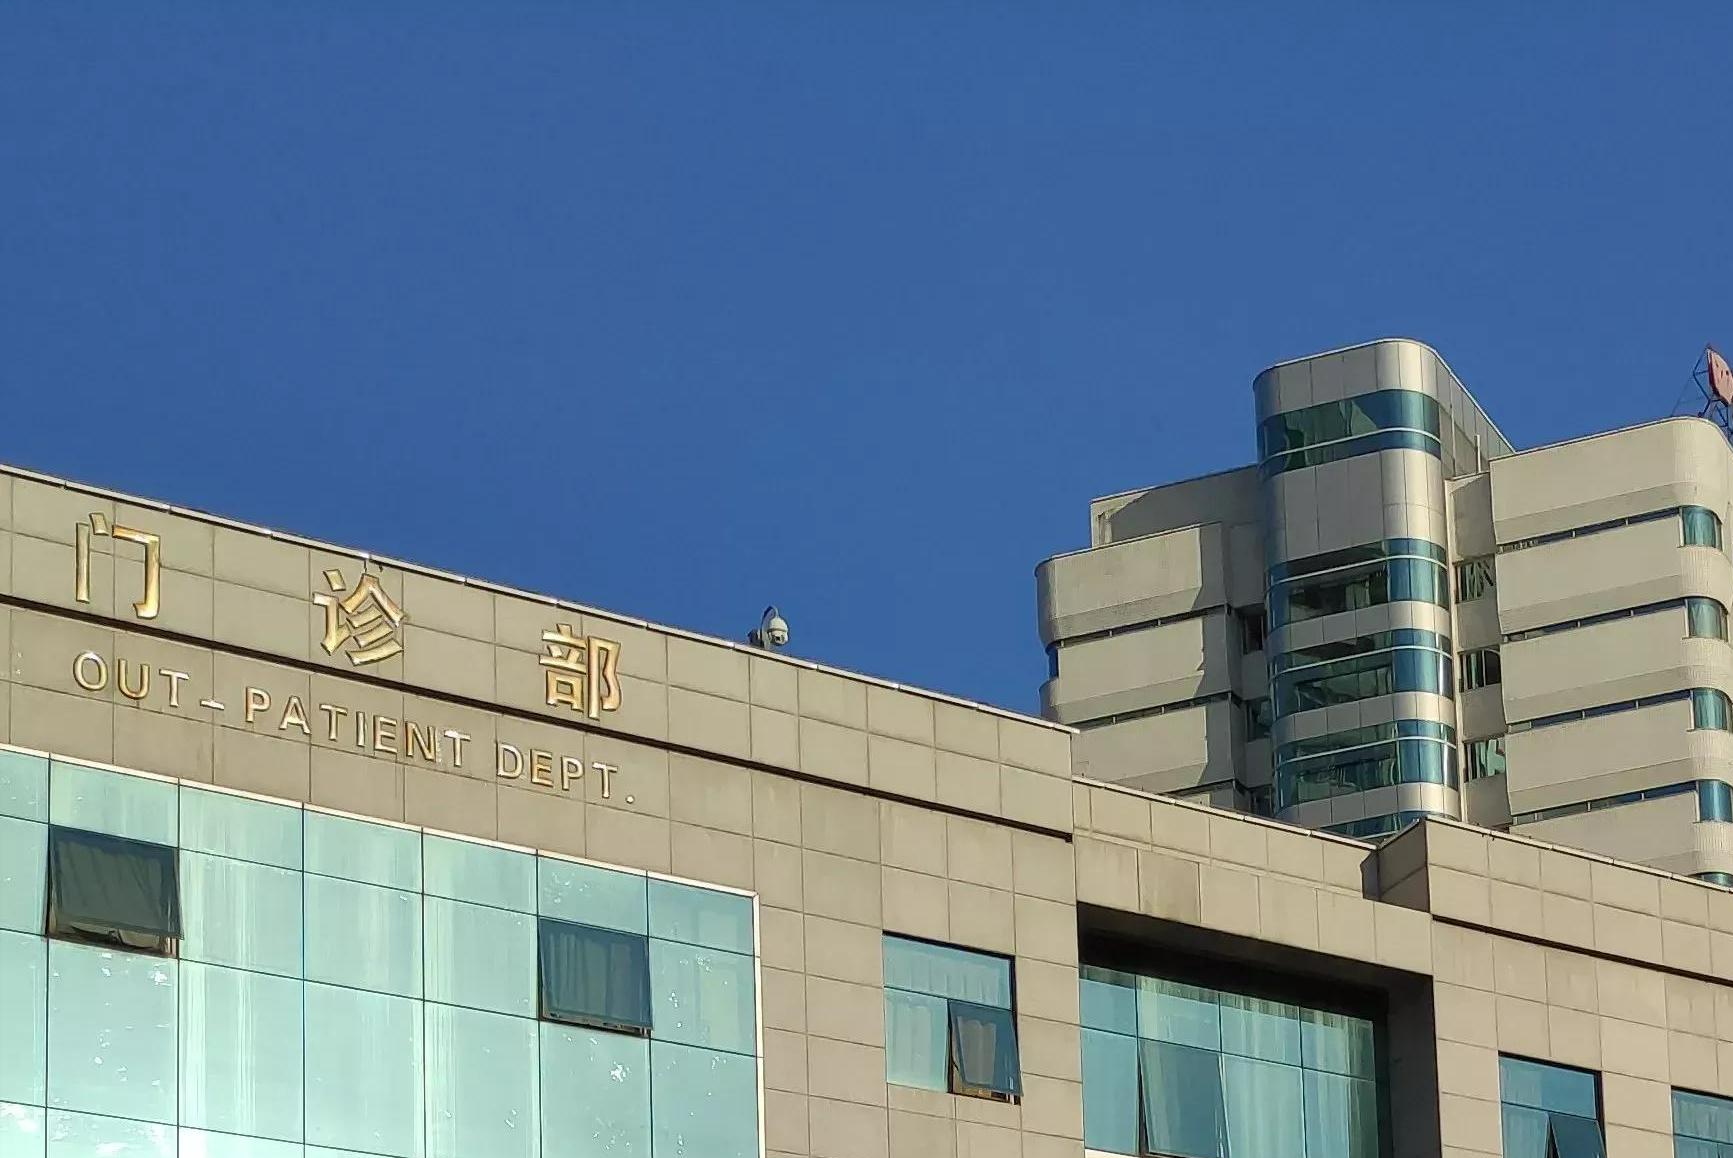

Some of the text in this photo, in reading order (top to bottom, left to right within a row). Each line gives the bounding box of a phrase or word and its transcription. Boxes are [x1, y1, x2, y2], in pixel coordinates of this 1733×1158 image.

[75, 512, 622, 720] 门诊部
[496, 741, 636, 805] DEPT.
